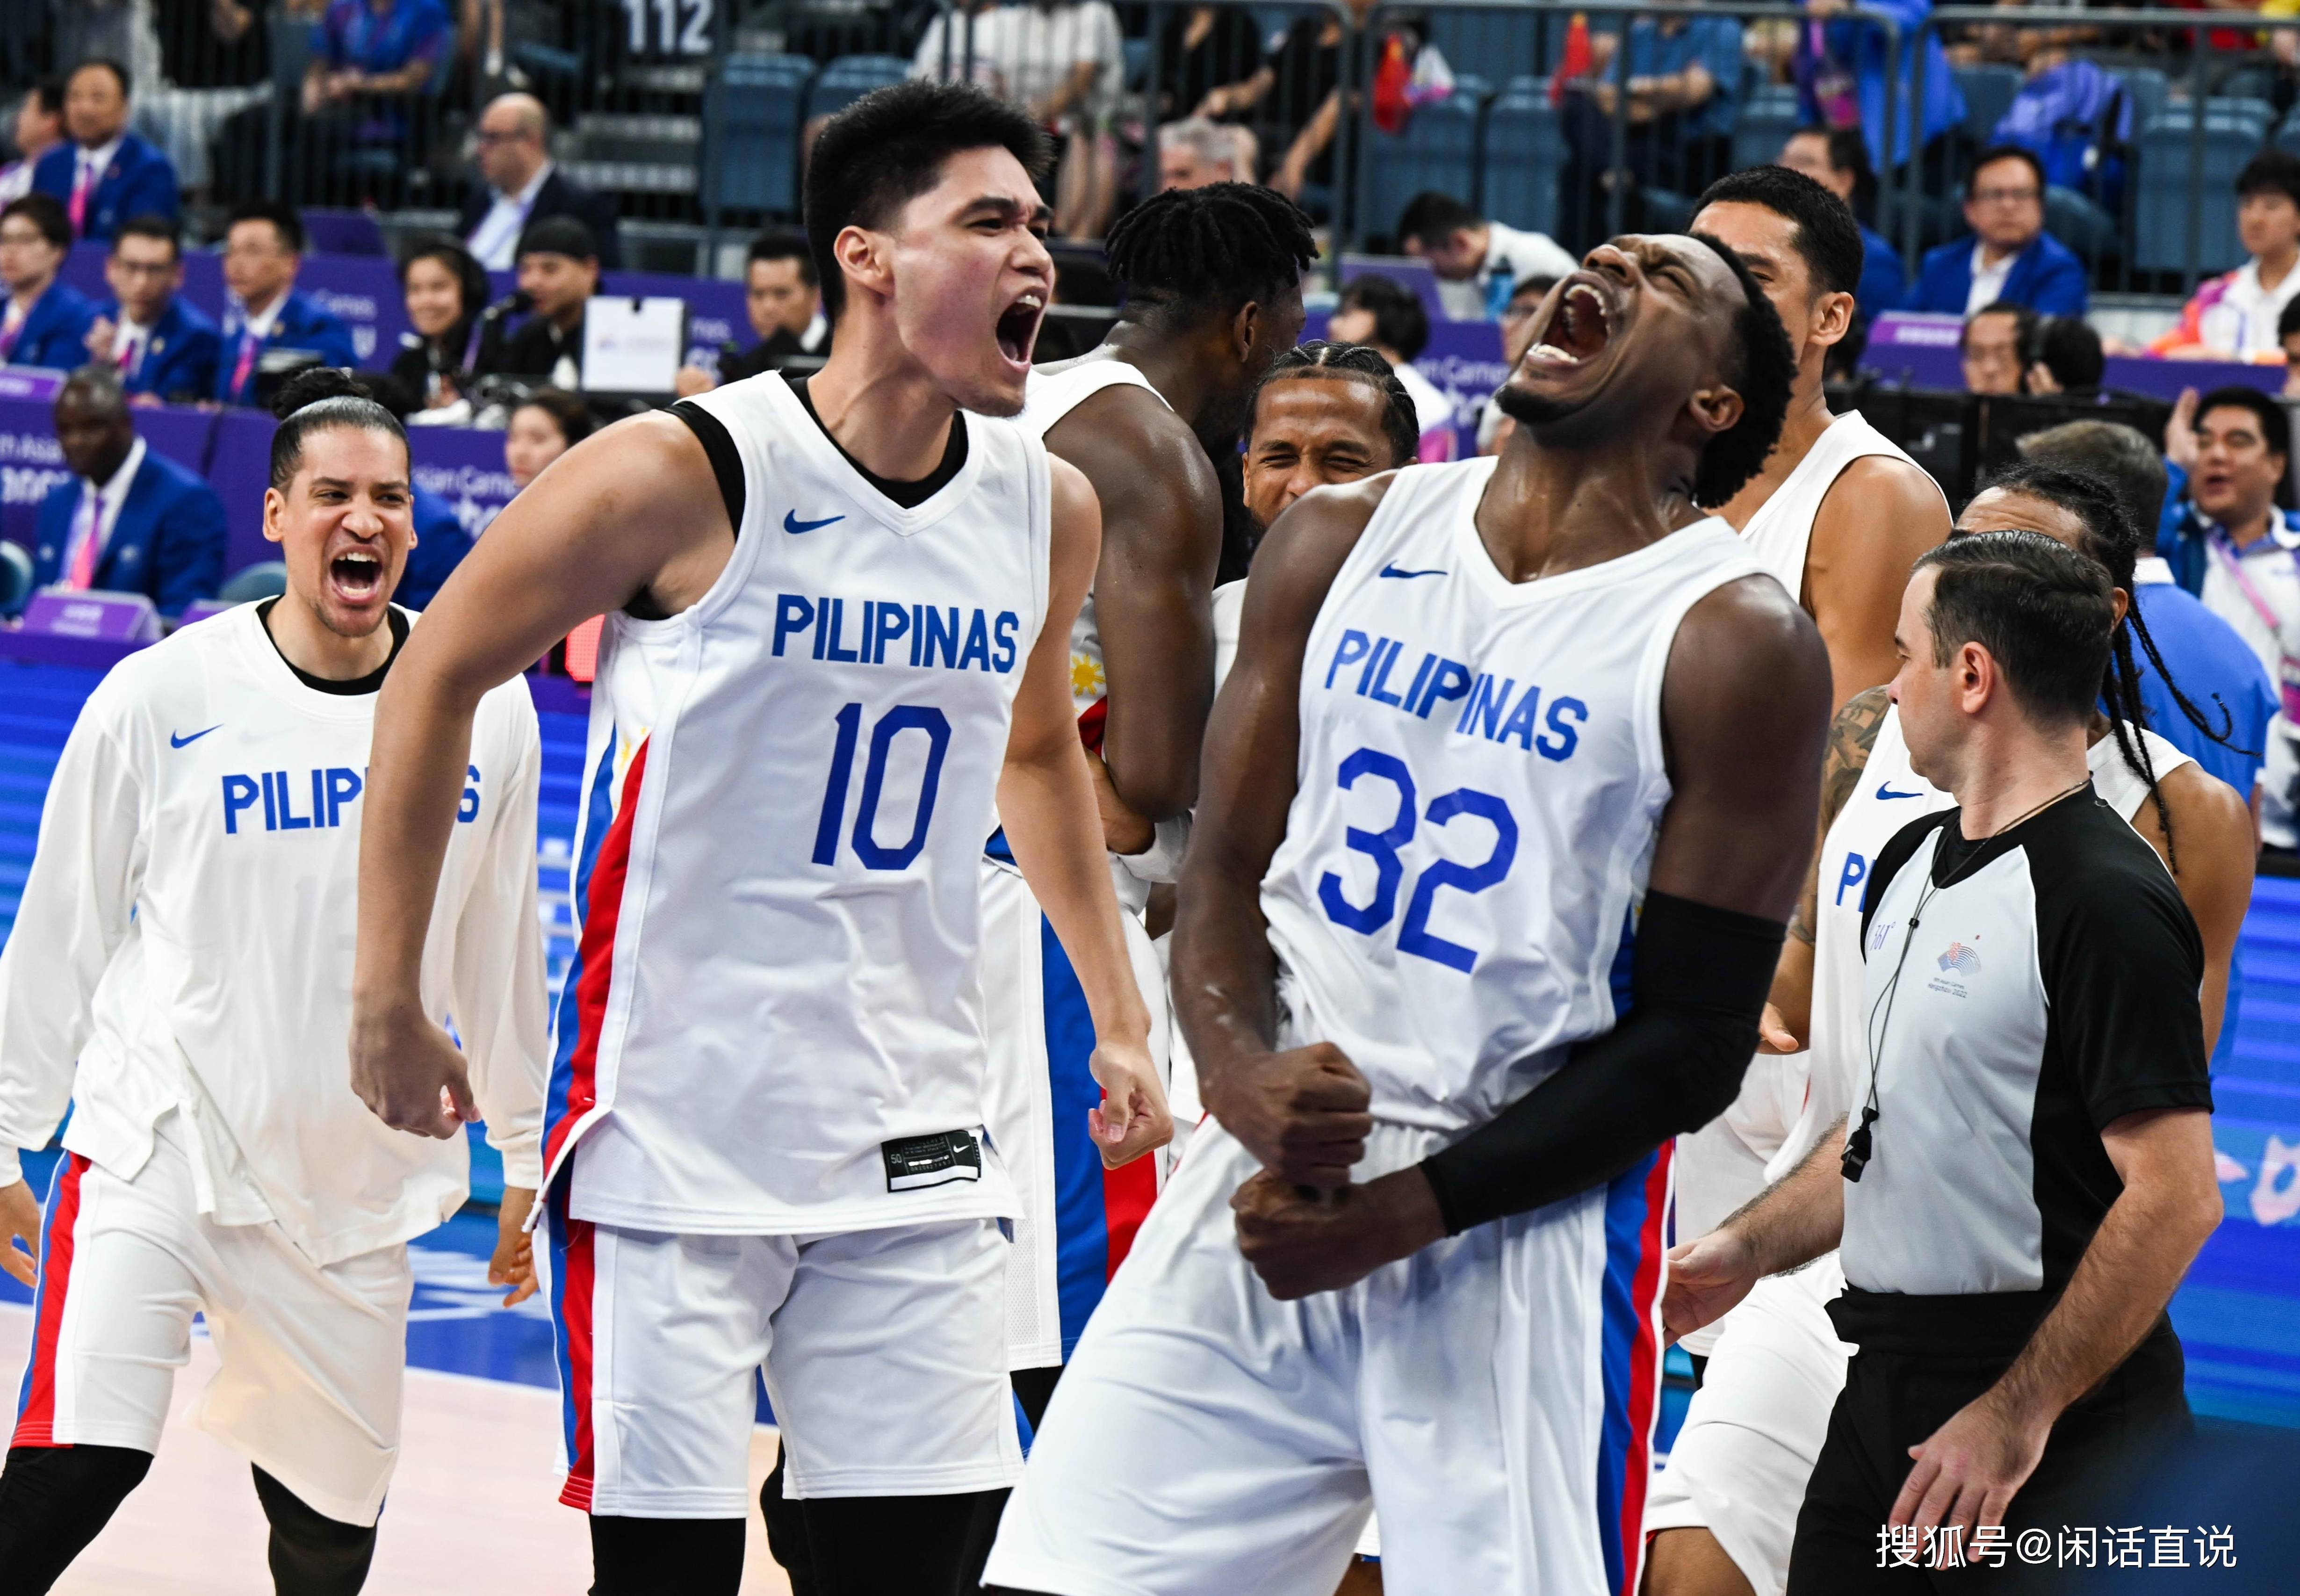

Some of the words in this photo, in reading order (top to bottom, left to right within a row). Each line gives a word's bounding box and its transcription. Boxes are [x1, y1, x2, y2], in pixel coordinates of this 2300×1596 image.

[621, 0, 713, 54] 112
[772, 593, 1019, 673] PILIPINAS
[1325, 629, 1588, 762] PILIPINAS
[222, 765, 481, 834] PILIPS
[812, 702, 952, 870] 10
[1317, 747, 1519, 974] 32
